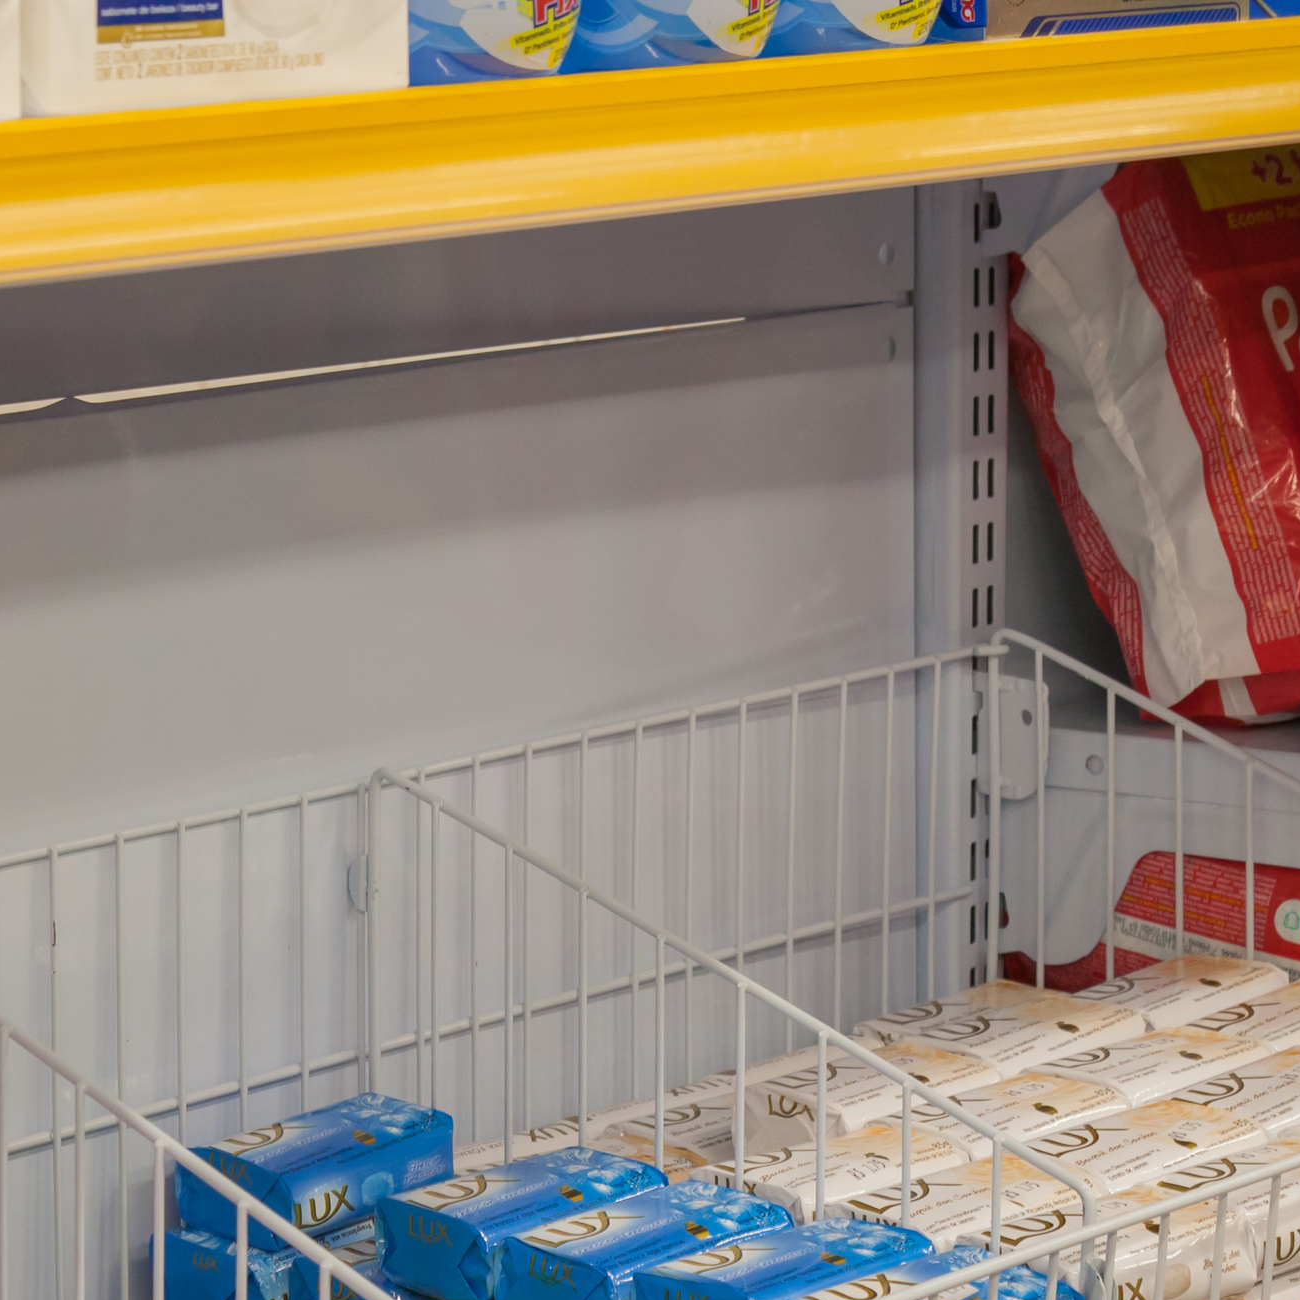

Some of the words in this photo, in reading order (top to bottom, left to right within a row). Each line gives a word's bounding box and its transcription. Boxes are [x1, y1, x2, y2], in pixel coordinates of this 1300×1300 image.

[923, 1016, 1018, 1042] LUX
[1186, 1002, 1281, 1032] LUX
[765, 1062, 868, 1090] LUX
[1174, 1072, 1274, 1107] LUX
[767, 1094, 815, 1122] LUX
[1028, 1123, 1130, 1158] LUX
[1156, 1157, 1269, 1192] LUX
[294, 1184, 356, 1229] LUX
[426, 1174, 521, 1212] LUX
[847, 1179, 963, 1214] LUX
[408, 1214, 455, 1247] LUX
[525, 1210, 644, 1248] LUX
[528, 1252, 577, 1292] LUX
[662, 1245, 778, 1275] LUX
